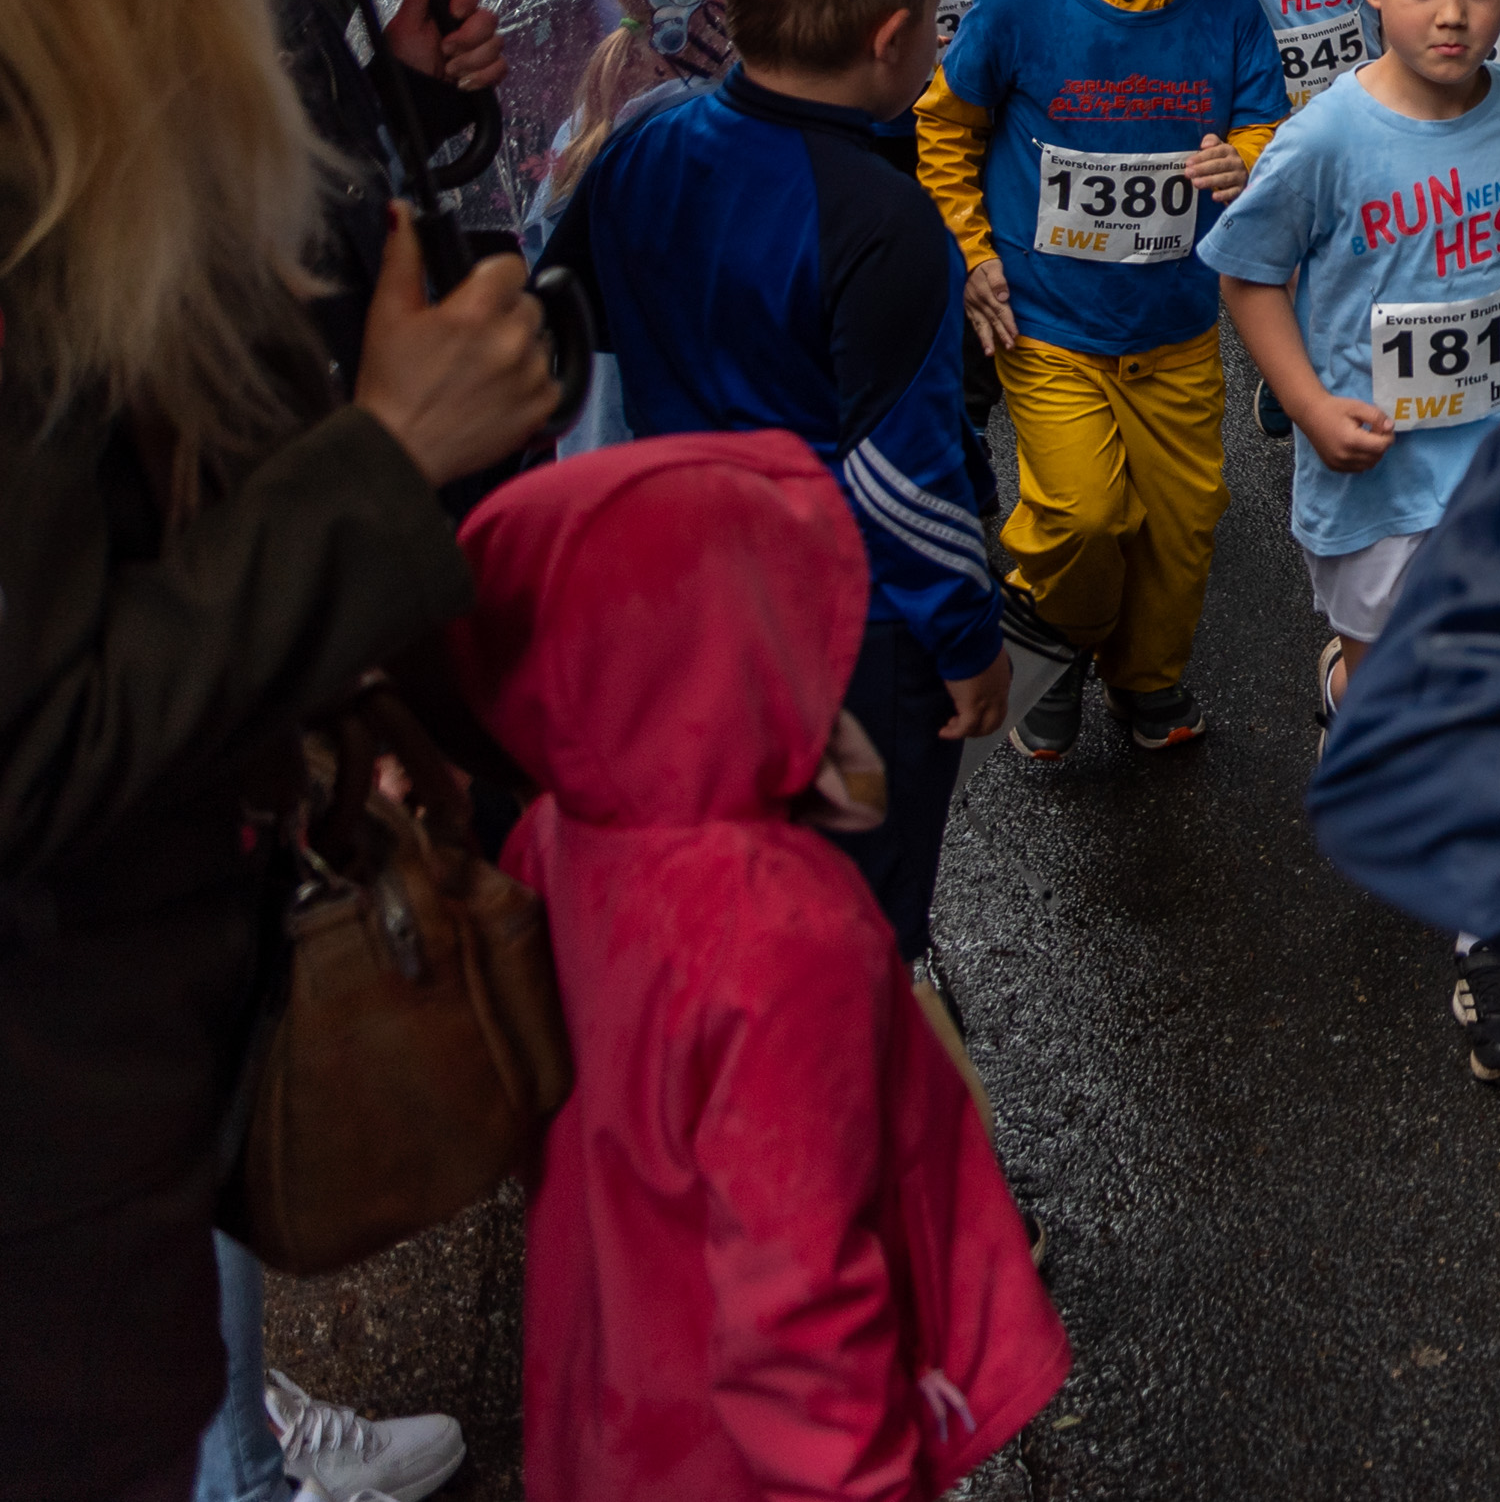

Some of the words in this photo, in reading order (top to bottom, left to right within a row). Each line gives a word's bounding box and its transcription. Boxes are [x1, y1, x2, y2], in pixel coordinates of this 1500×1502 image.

[1302, 19, 1355, 40] Brunnenlauf
[1280, 28, 1363, 79] 845
[1300, 76, 1328, 87] Paula
[1051, 155, 1116, 172] Everstener
[1048, 170, 1194, 218] 1380
[1094, 220, 1140, 230] Marven
[1050, 226, 1110, 251] EWE
[1134, 232, 1181, 250] bruns
[1386, 313, 1466, 325] Everstener
[1455, 373, 1488, 388] Titus
[1394, 392, 1464, 420] EWE
